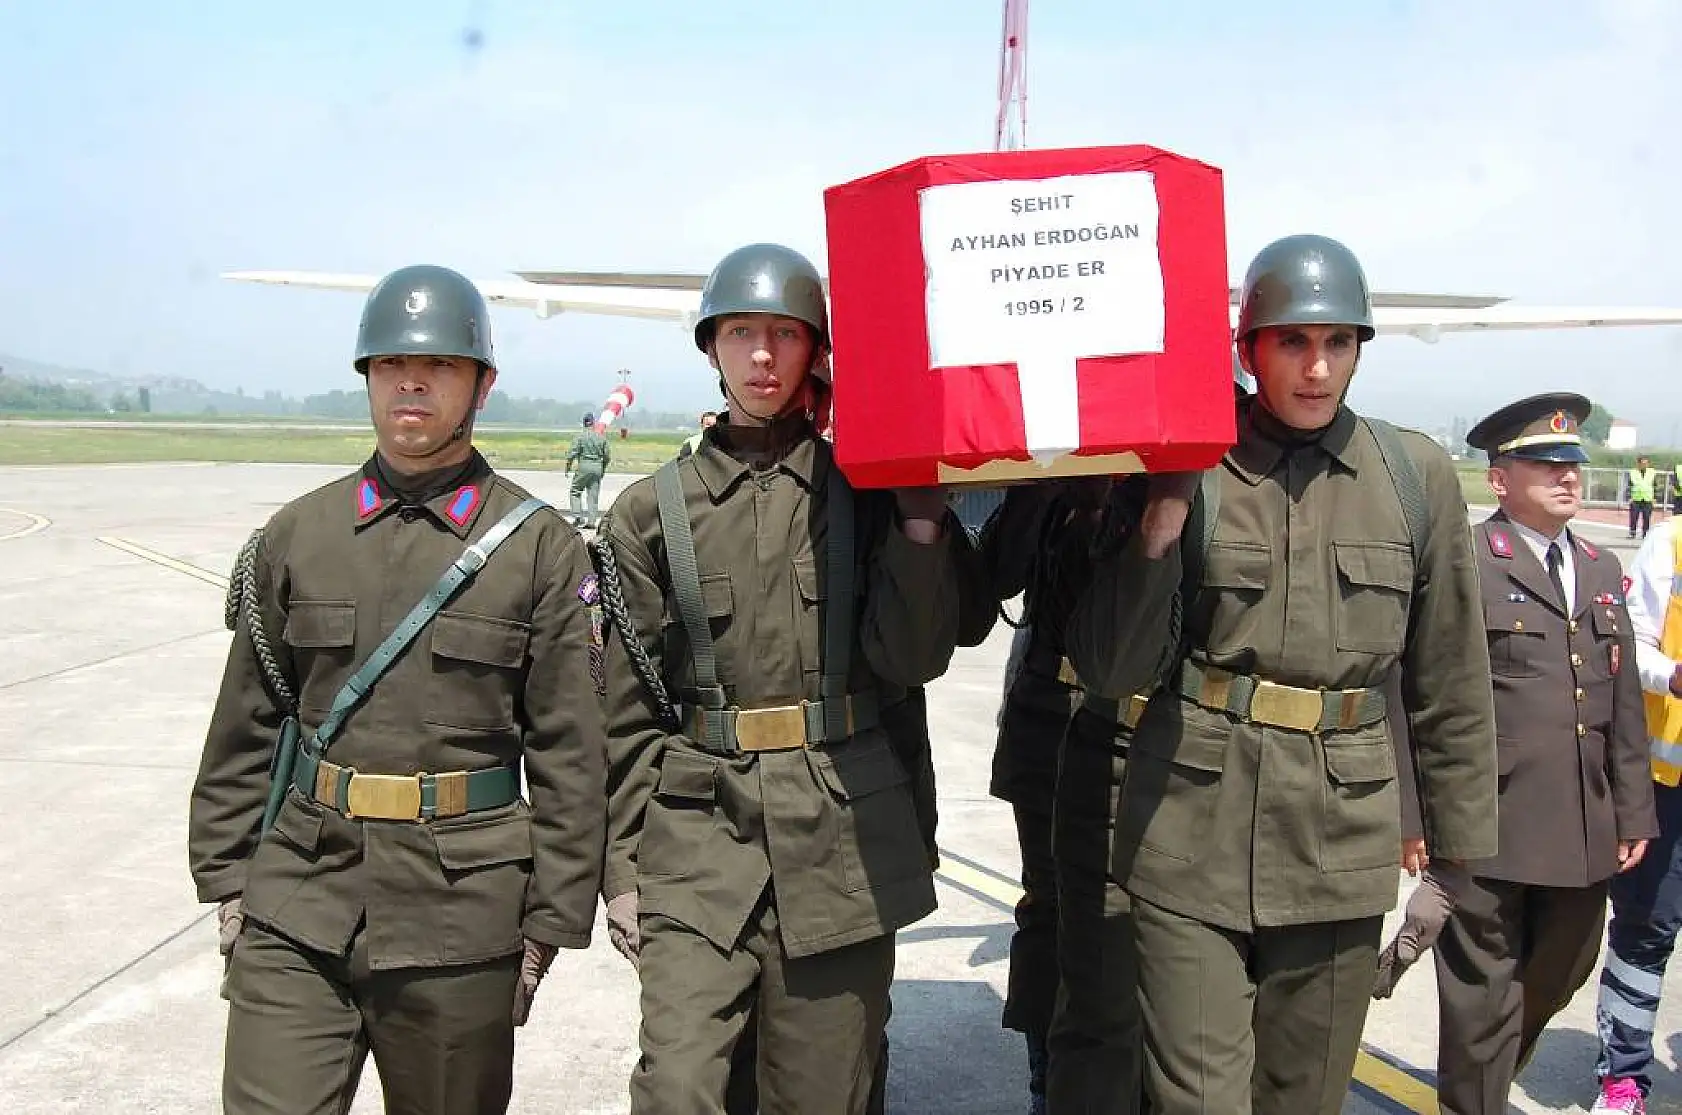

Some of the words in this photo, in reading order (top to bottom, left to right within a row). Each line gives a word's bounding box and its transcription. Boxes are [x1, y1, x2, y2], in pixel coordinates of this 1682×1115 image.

[1011, 193, 1074, 216] ŞEHİT
[951, 232, 1026, 252] AYHAN
[1034, 223, 1139, 247] ERDOĞAN
[991, 263, 1070, 283] PİYADE
[1077, 260, 1105, 277] ER
[1004, 299, 1054, 316] 1995
[1073, 296, 1085, 312] 2
